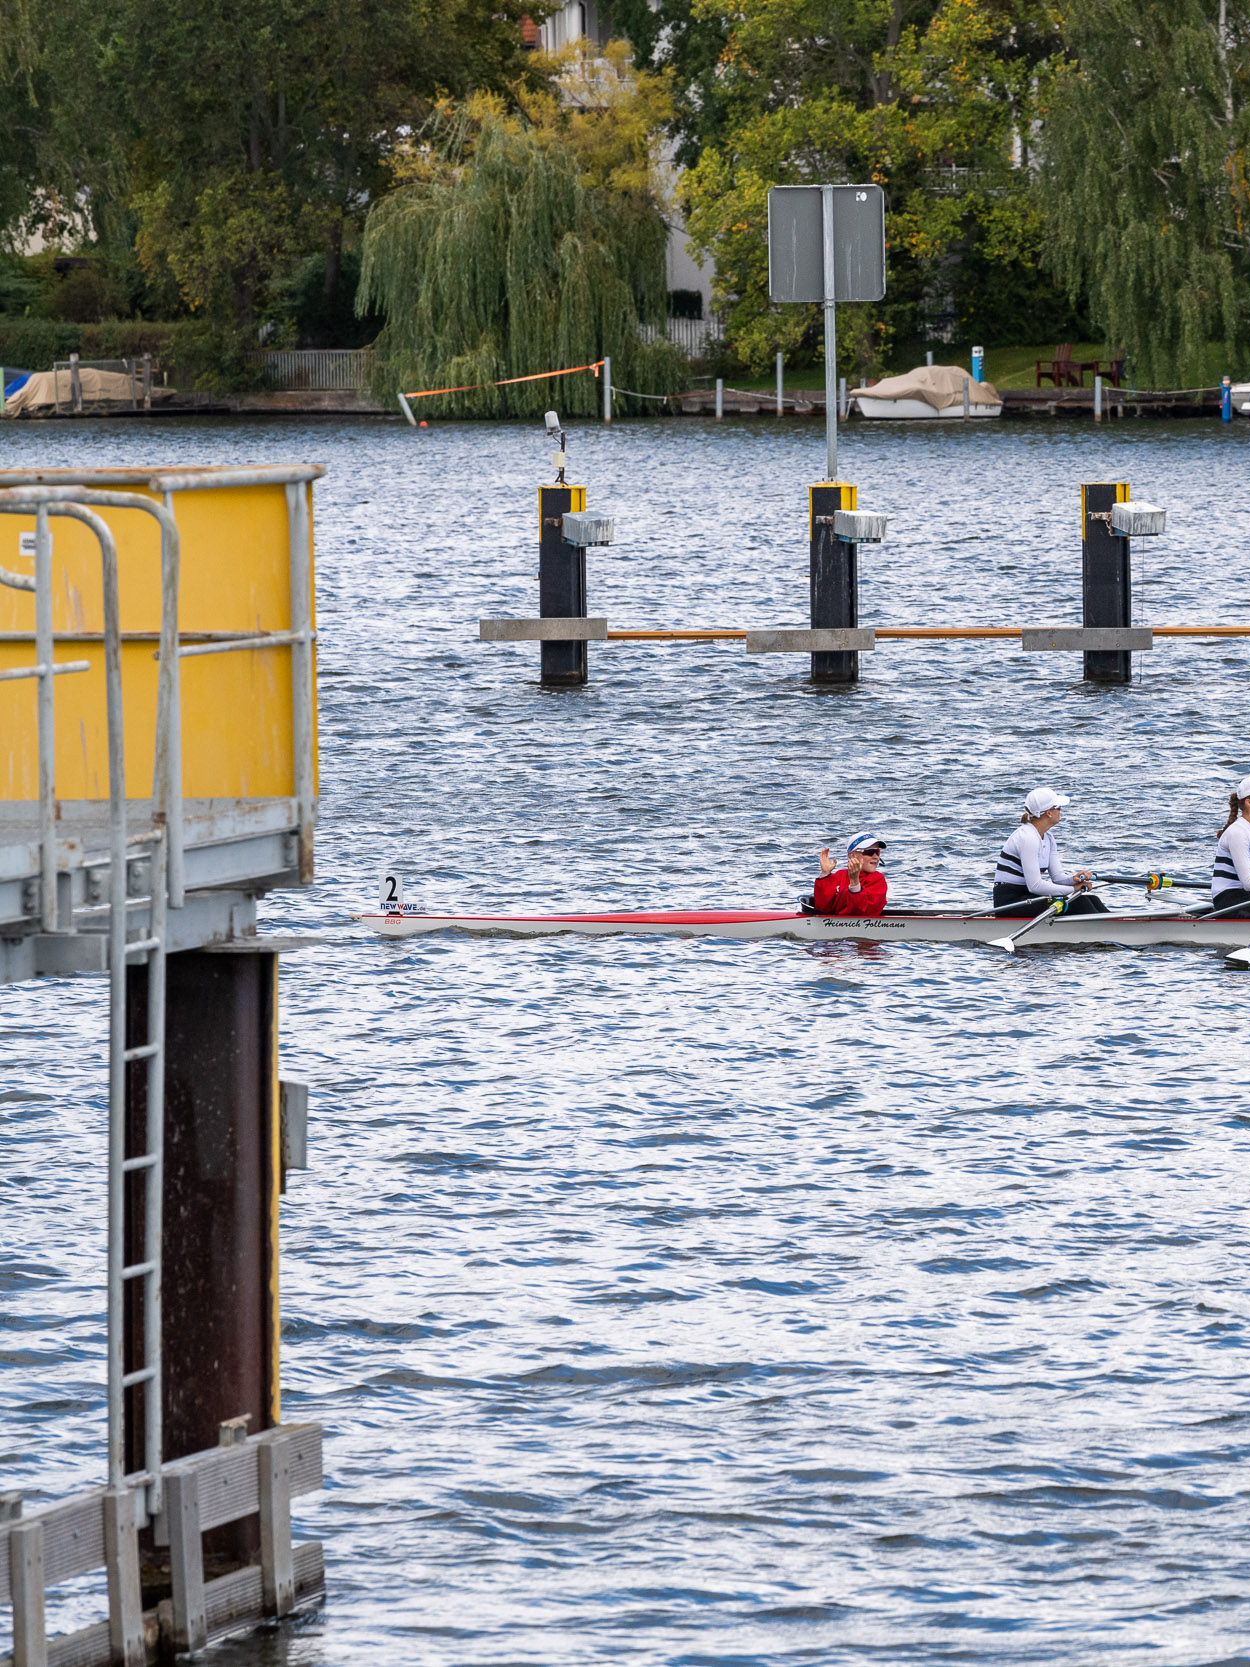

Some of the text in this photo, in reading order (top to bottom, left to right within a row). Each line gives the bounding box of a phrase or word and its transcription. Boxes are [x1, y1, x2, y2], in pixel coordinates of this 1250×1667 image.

[385, 876, 398, 901] 2
[823, 919, 906, 929] Heinrich Follmann
